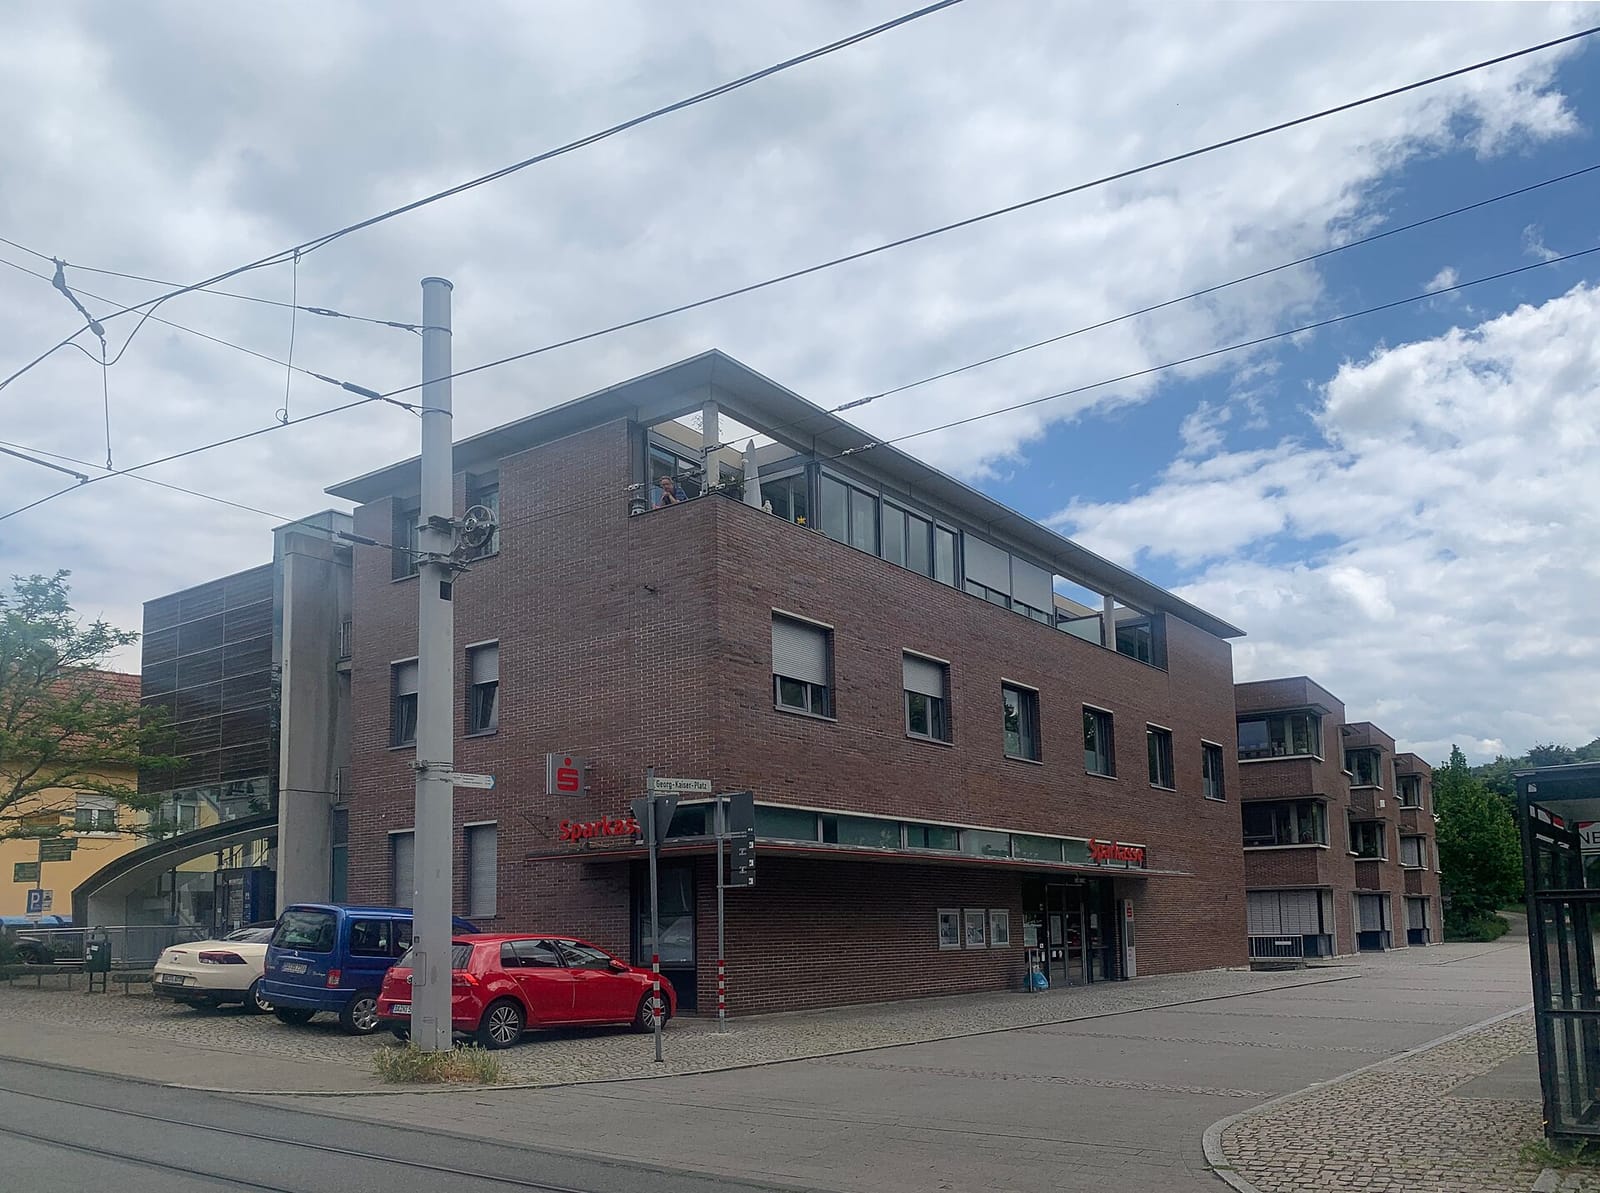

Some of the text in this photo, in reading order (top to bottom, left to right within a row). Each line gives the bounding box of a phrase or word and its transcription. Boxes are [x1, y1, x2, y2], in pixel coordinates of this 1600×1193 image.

[655, 779, 708, 790] Georg-Kaiser-Platz
[559, 815, 642, 844] Sparkas
[1088, 836, 1143, 864] Sparkasse
[30, 892, 41, 911] P
